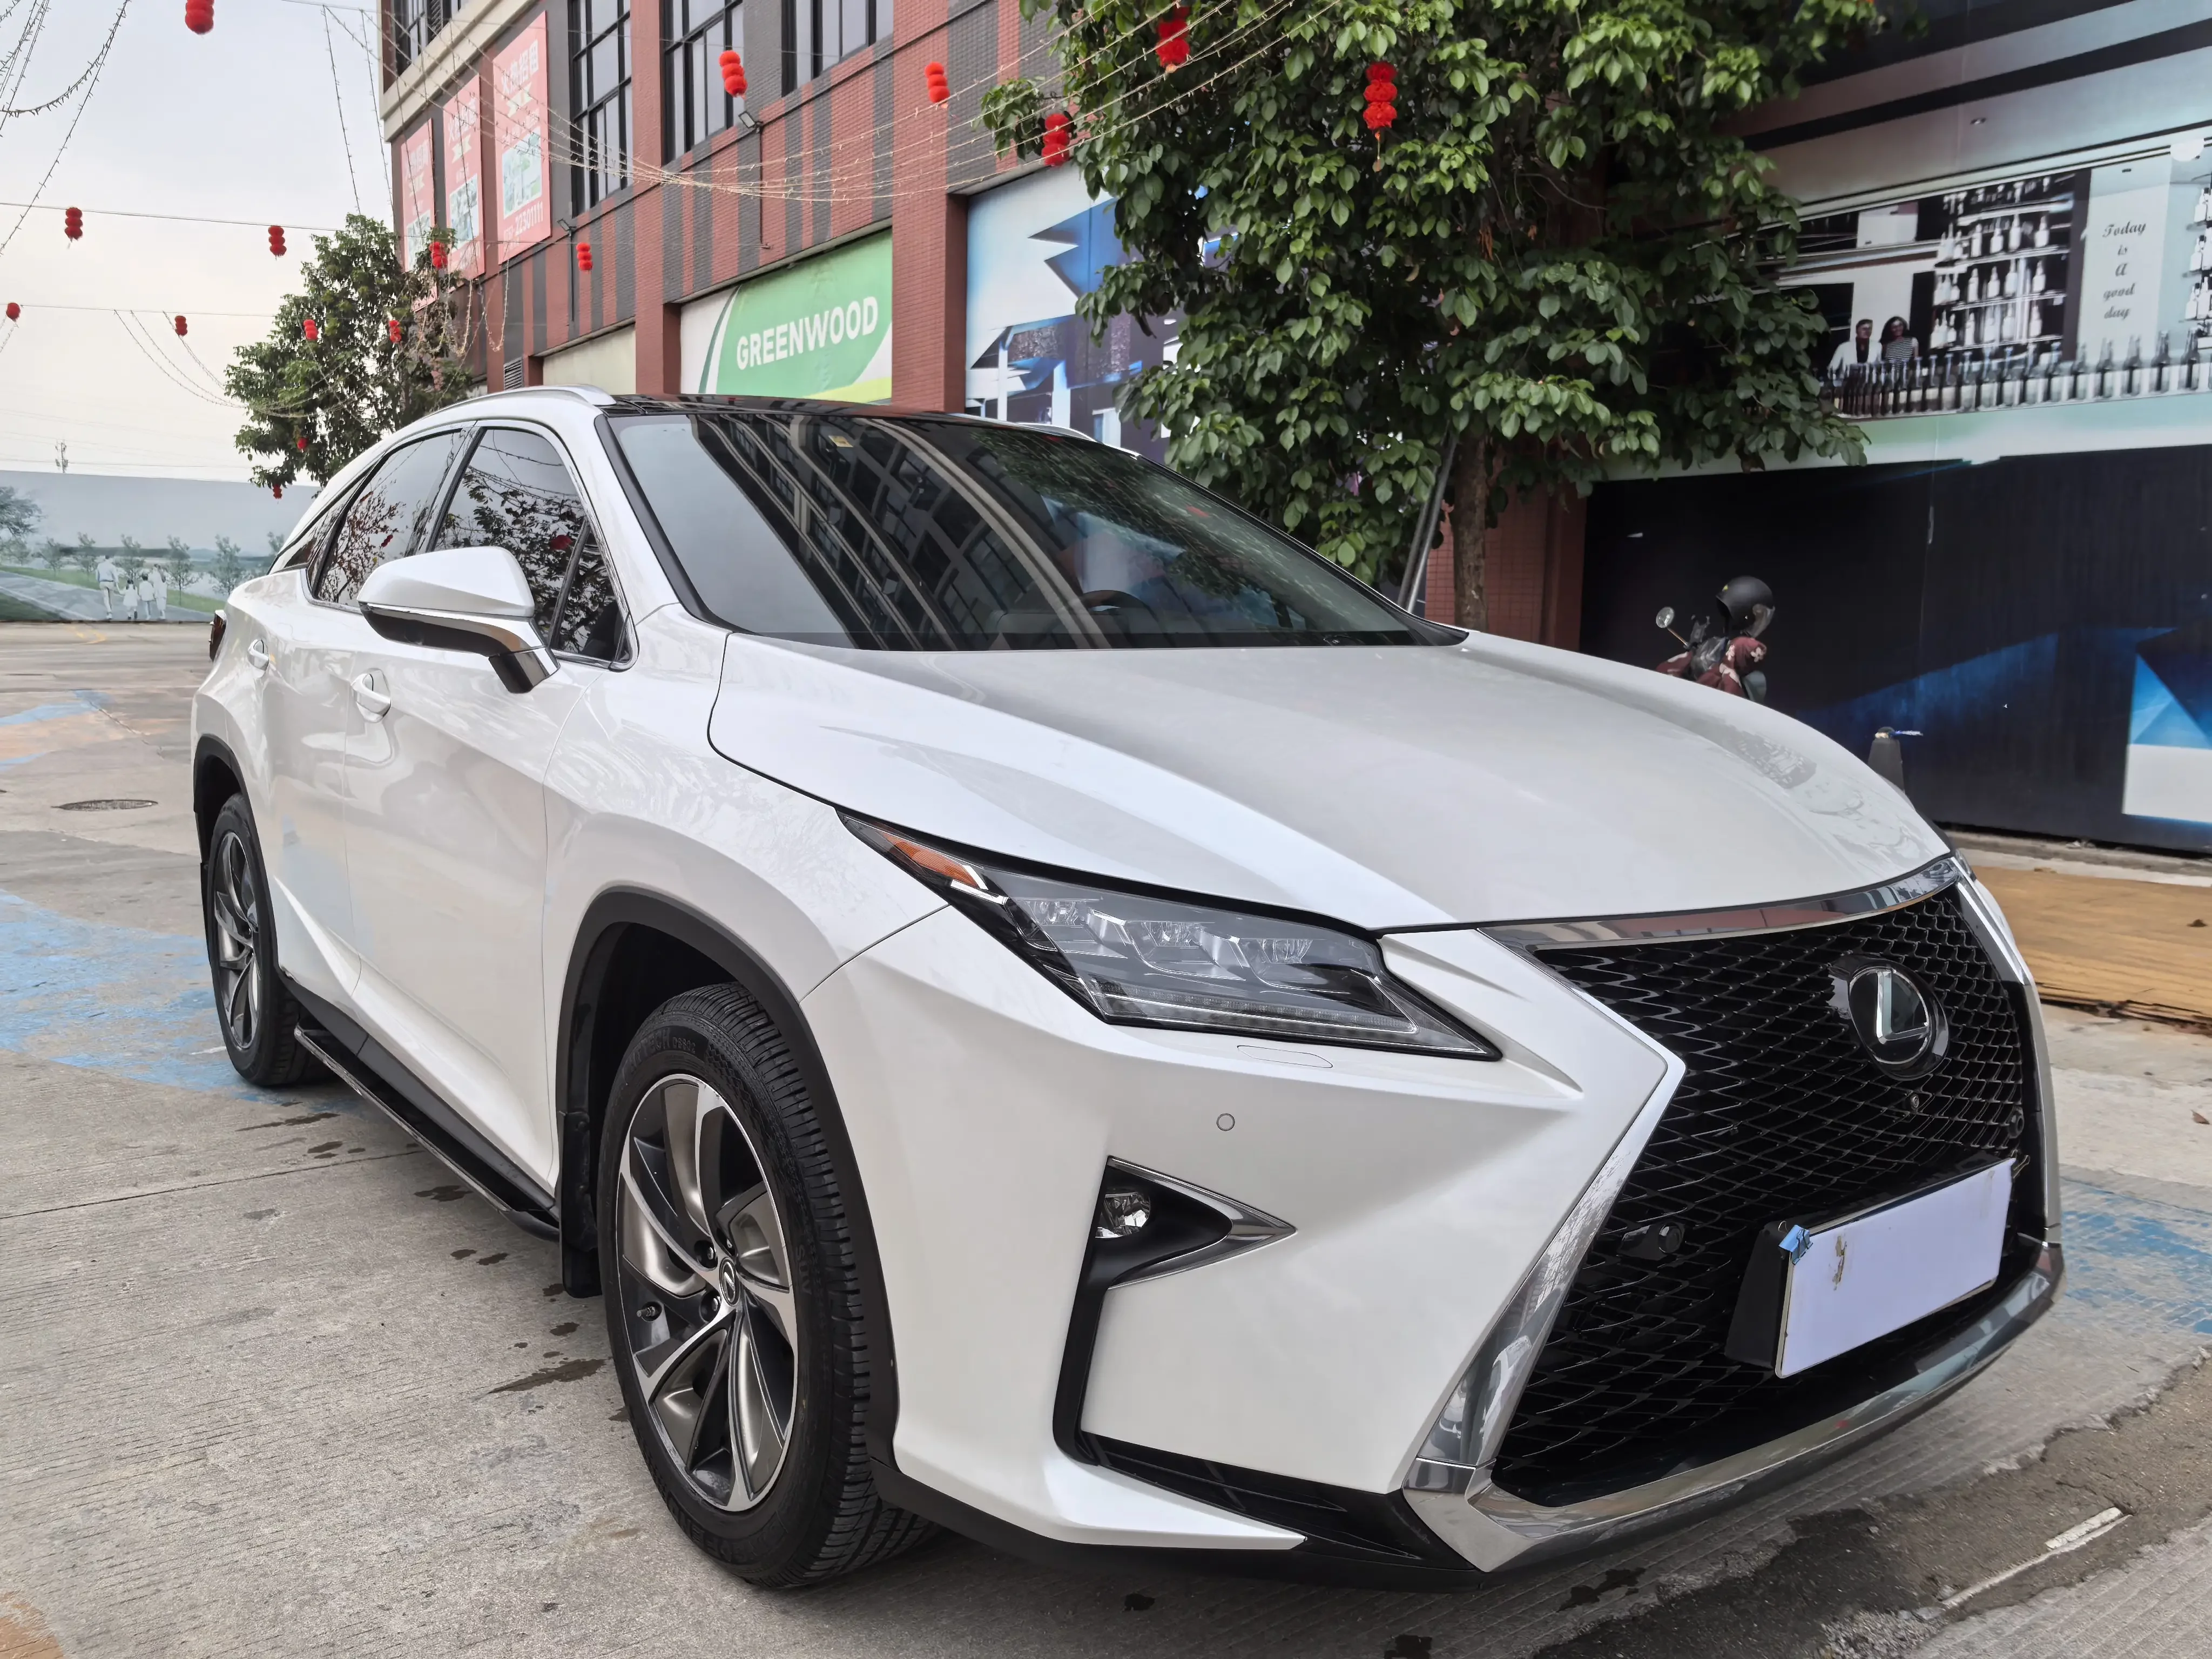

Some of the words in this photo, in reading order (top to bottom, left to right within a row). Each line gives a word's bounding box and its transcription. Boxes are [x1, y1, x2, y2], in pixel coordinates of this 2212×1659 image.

[2102, 221, 2147, 238] Today
[2117, 245, 2128, 256] is
[2103, 282, 2136, 302] good
[2104, 305, 2130, 320] day
[737, 296, 878, 370] GREENWOOD
